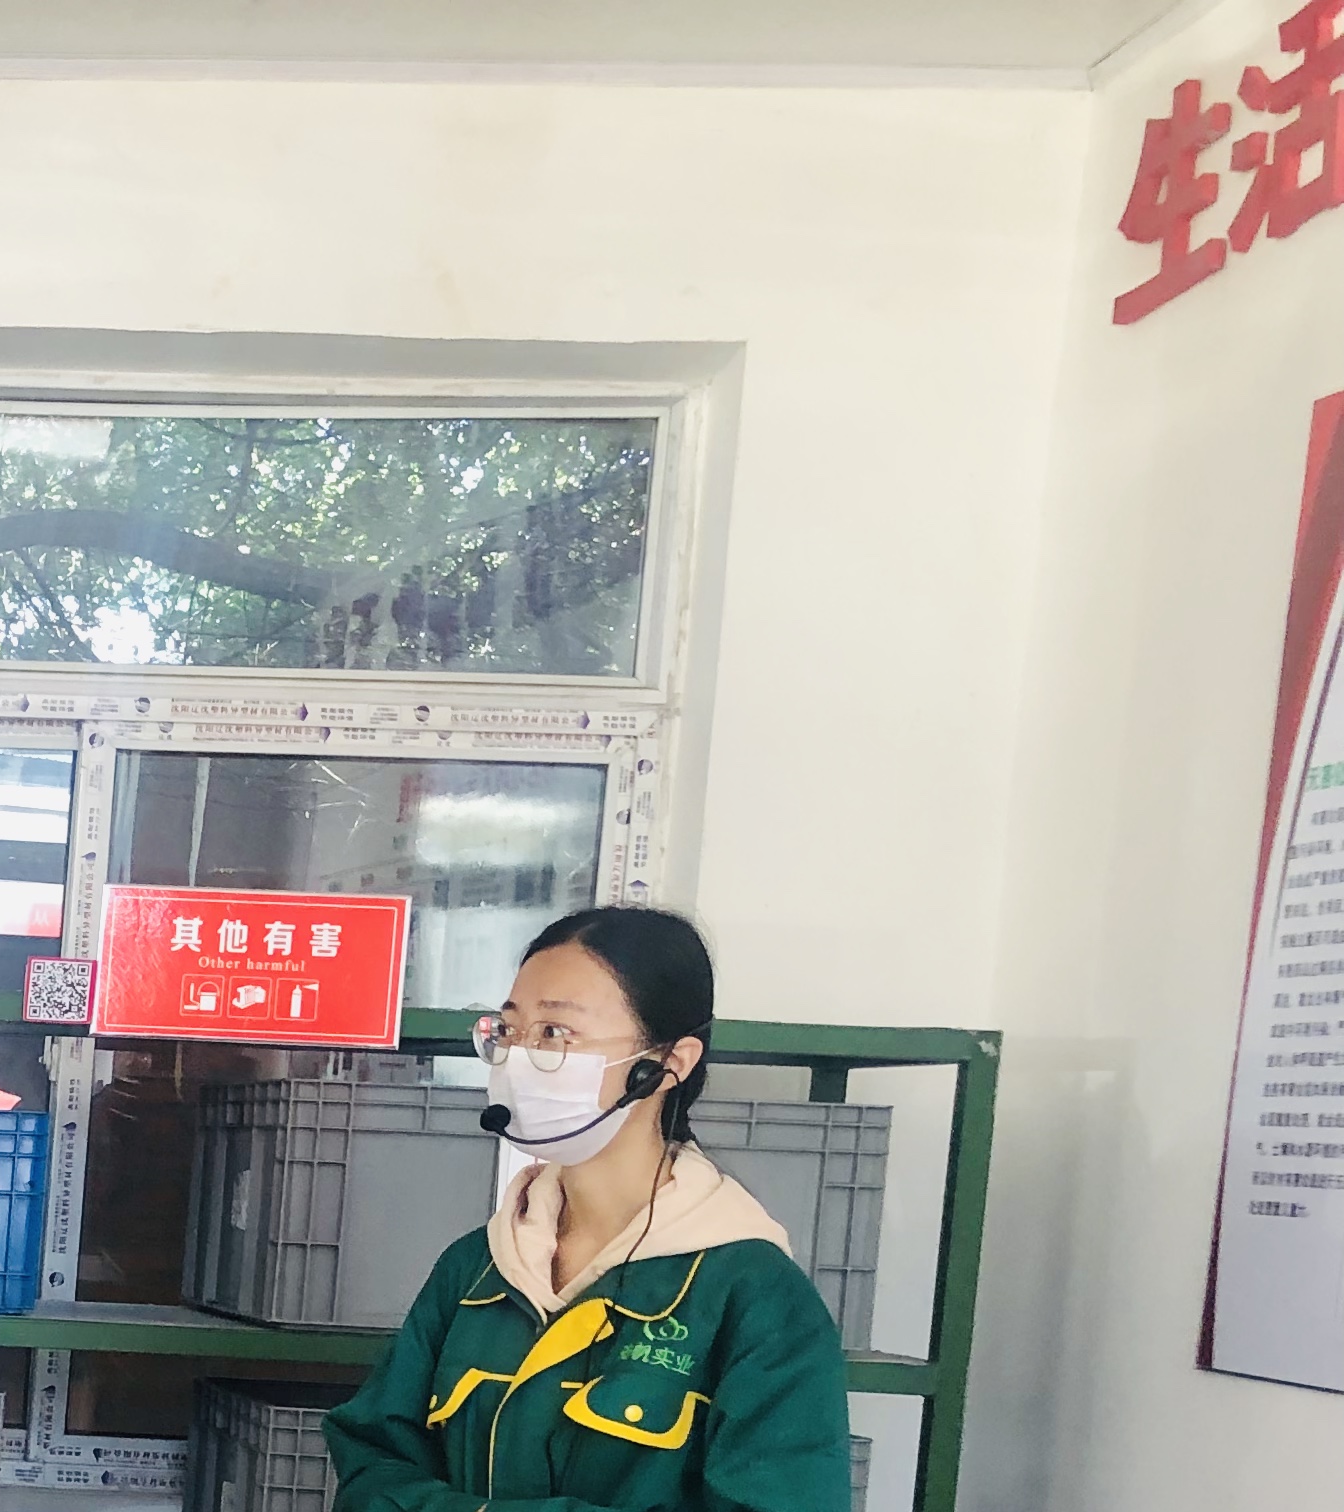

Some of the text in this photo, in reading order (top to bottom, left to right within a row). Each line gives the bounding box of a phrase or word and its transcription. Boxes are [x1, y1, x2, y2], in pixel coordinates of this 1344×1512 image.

[170, 916, 342, 958] 其他有害
[198, 957, 306, 972] Other harmful
